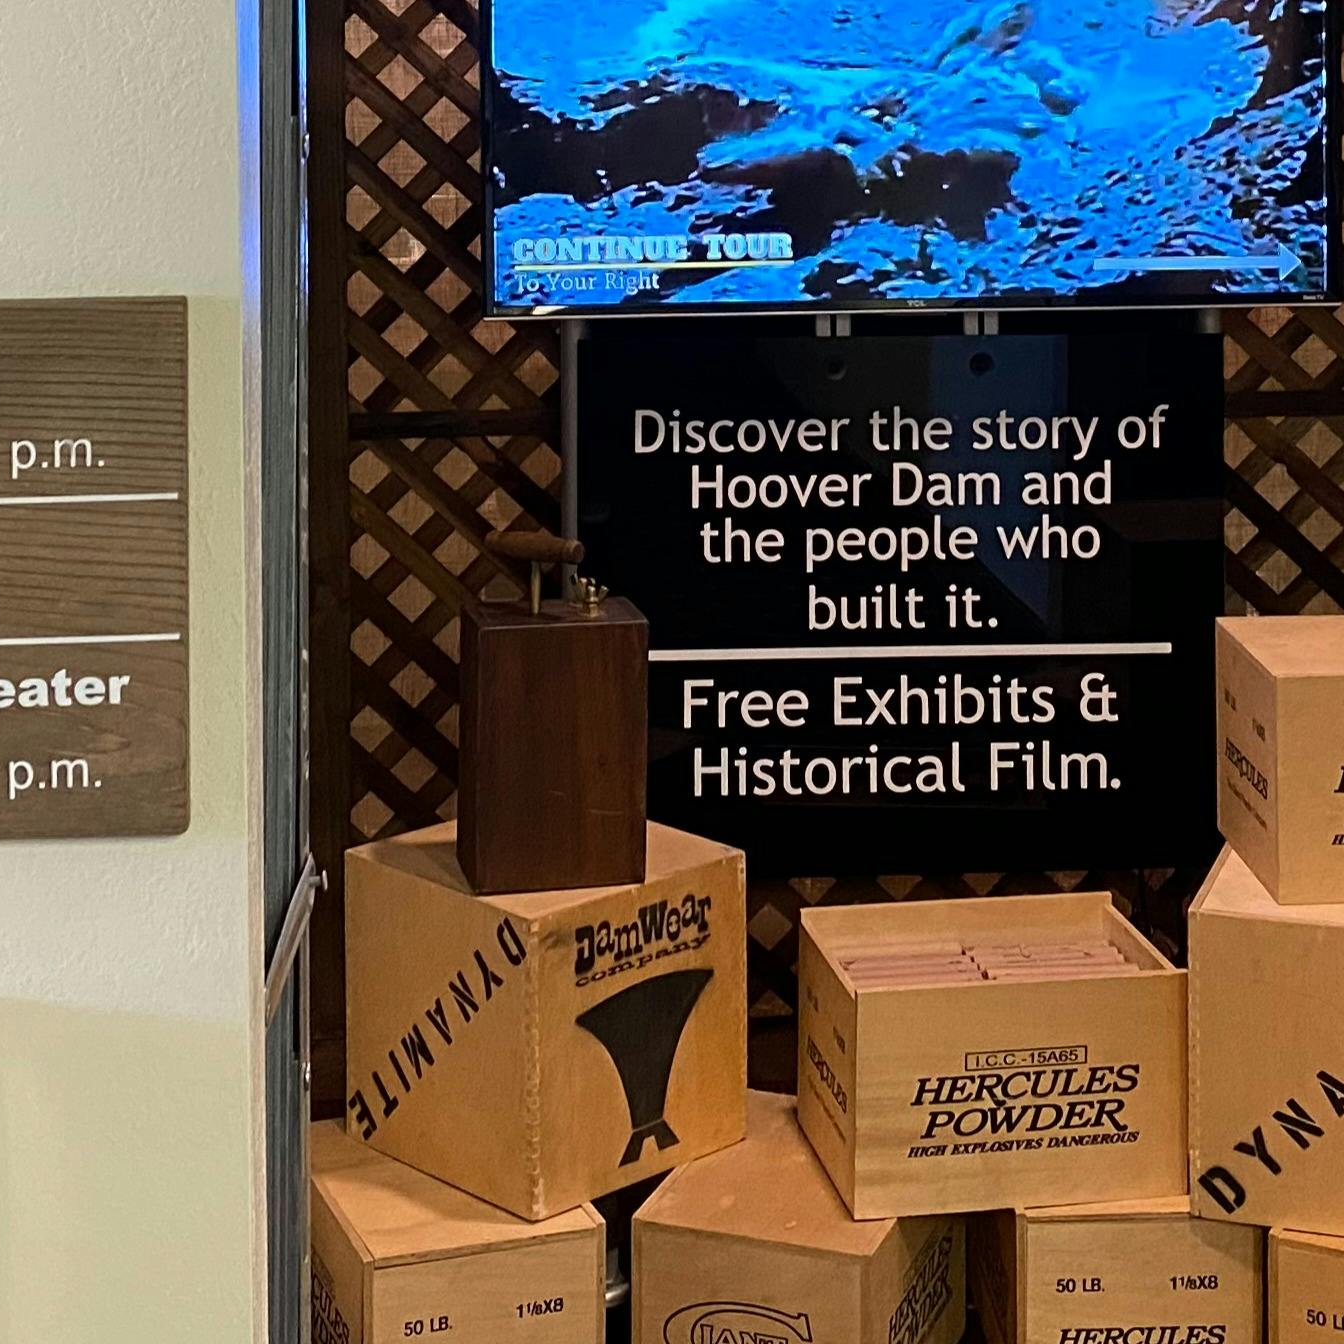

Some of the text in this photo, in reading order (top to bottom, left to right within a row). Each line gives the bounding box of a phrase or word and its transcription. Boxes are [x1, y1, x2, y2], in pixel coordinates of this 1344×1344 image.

[513, 232, 794, 264] CONTINUE TOUR
[514, 270, 660, 296] To Your Right
[635, 404, 1170, 460] Discover the story of
[11, 434, 106, 479] p.m.
[690, 459, 1112, 510] Hoover Dam and
[700, 514, 1101, 573] the people who
[808, 584, 999, 632] built it.
[681, 672, 1120, 731] Free Exhibits &
[7, 755, 103, 800] p.m.
[692, 739, 1123, 798] Historical Film.
[575, 893, 712, 976] DamWear
[575, 932, 712, 988] company
[347, 917, 527, 1141] DYNAMITE
[910, 1063, 1141, 1107] HERCULES
[920, 1098, 1129, 1141] POWDER
[907, 1131, 1141, 1158] HIGH EXPLOSIVES DANGEROUS
[1056, 1277, 1076, 1293] 50
[1082, 1277, 1105, 1292] LB.
[403, 1319, 424, 1337] 50
[430, 1315, 453, 1334] LB.
[1306, 1309, 1327, 1327] 50
